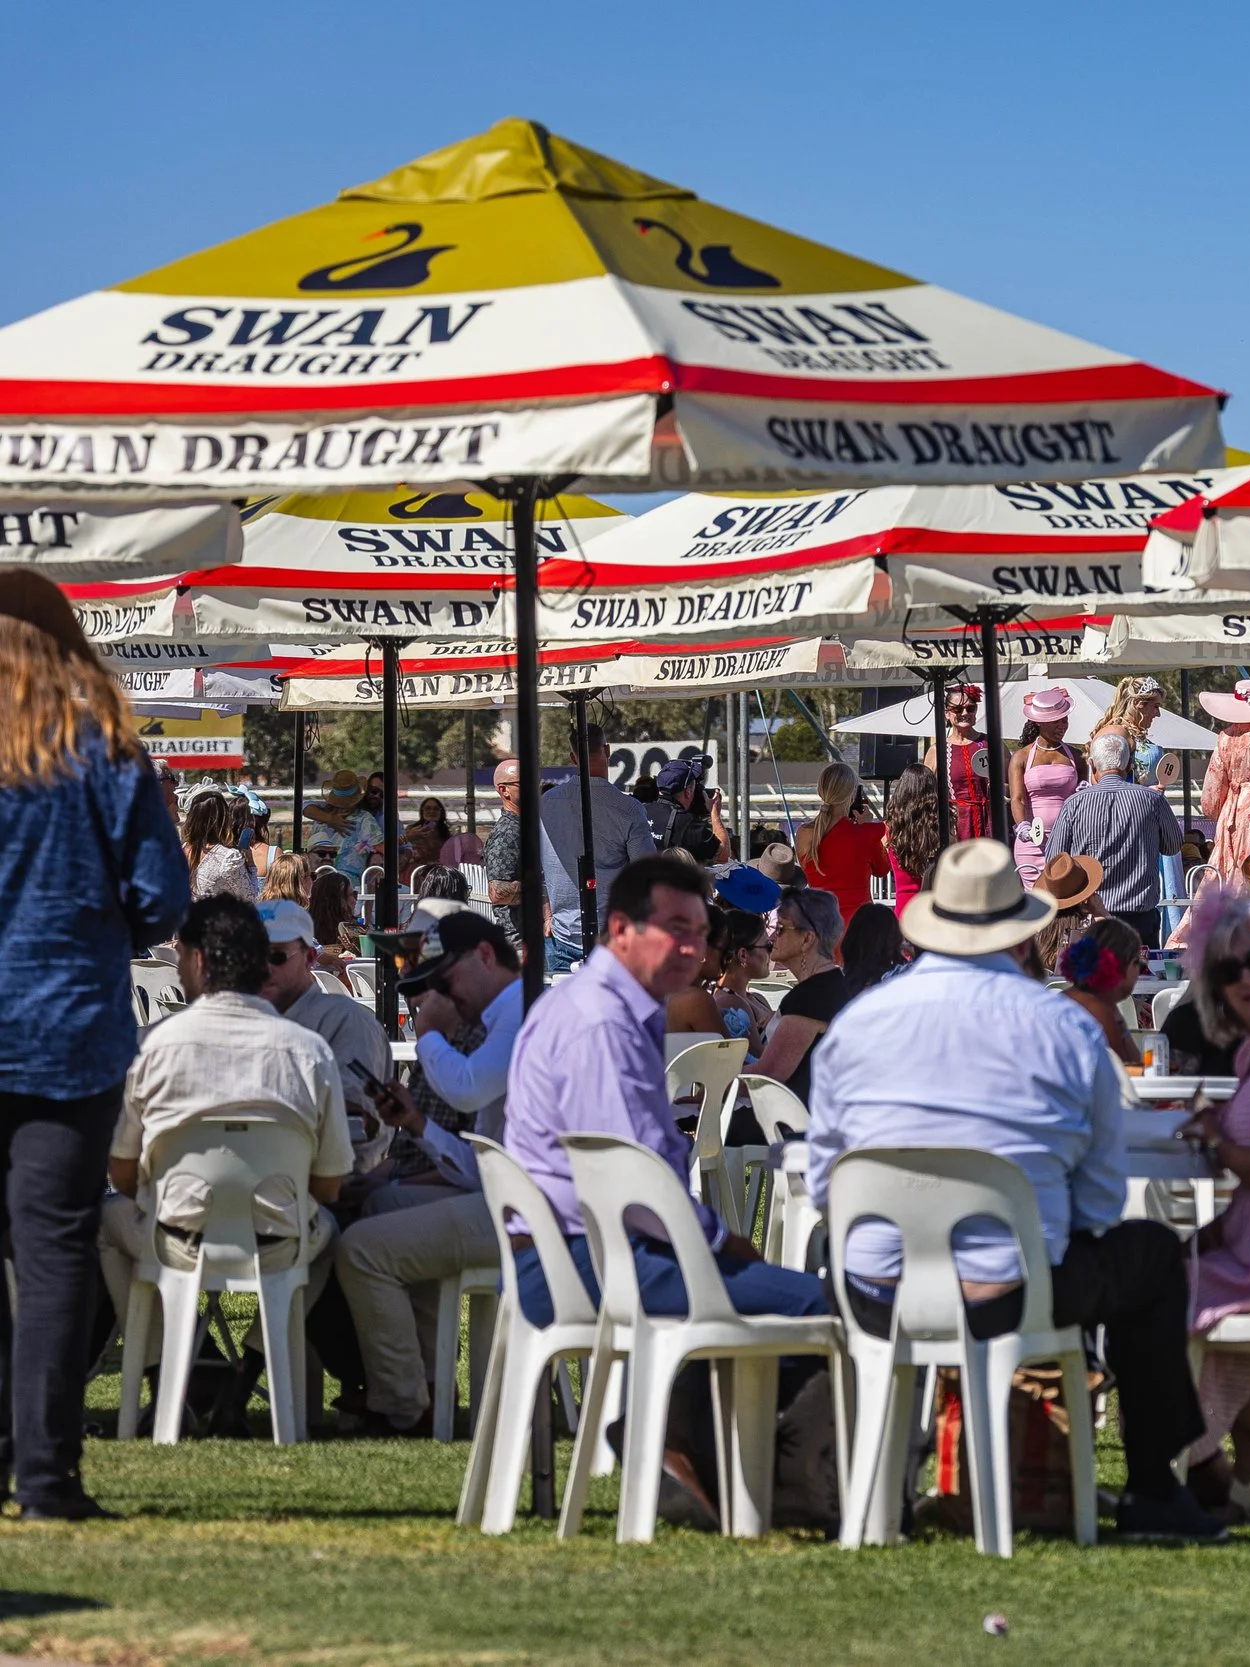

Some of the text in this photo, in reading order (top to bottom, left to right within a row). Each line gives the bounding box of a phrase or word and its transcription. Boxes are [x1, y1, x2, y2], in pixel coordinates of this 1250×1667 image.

[139, 302, 495, 347] SWAN
[681, 300, 930, 344] SWAN
[138, 351, 423, 375] DRAUGHT
[760, 347, 951, 371] DRAUGHT
[0, 422, 499, 473] WAN DRAUGHT
[767, 417, 1122, 467] SWAN DRAUGHT
[693, 490, 868, 539] SWAN
[1041, 513, 1158, 529] DRAU
[337, 527, 568, 552] SWAN
[680, 530, 813, 558] DRAUGHT
[370, 554, 518, 568] DRAUG
[993, 564, 1124, 596] SWAN
[302, 597, 433, 627] SWAN
[571, 598, 668, 629] SWAN
[672, 582, 813, 625] DRAUGHT
[429, 642, 549, 656] DRAUGT
[449, 664, 598, 694] DRAGHT
[654, 648, 791, 681] SWAN DRAUGHT
[117, 671, 171, 692] RAUGHT
[1164, 762, 1174, 777] 19
